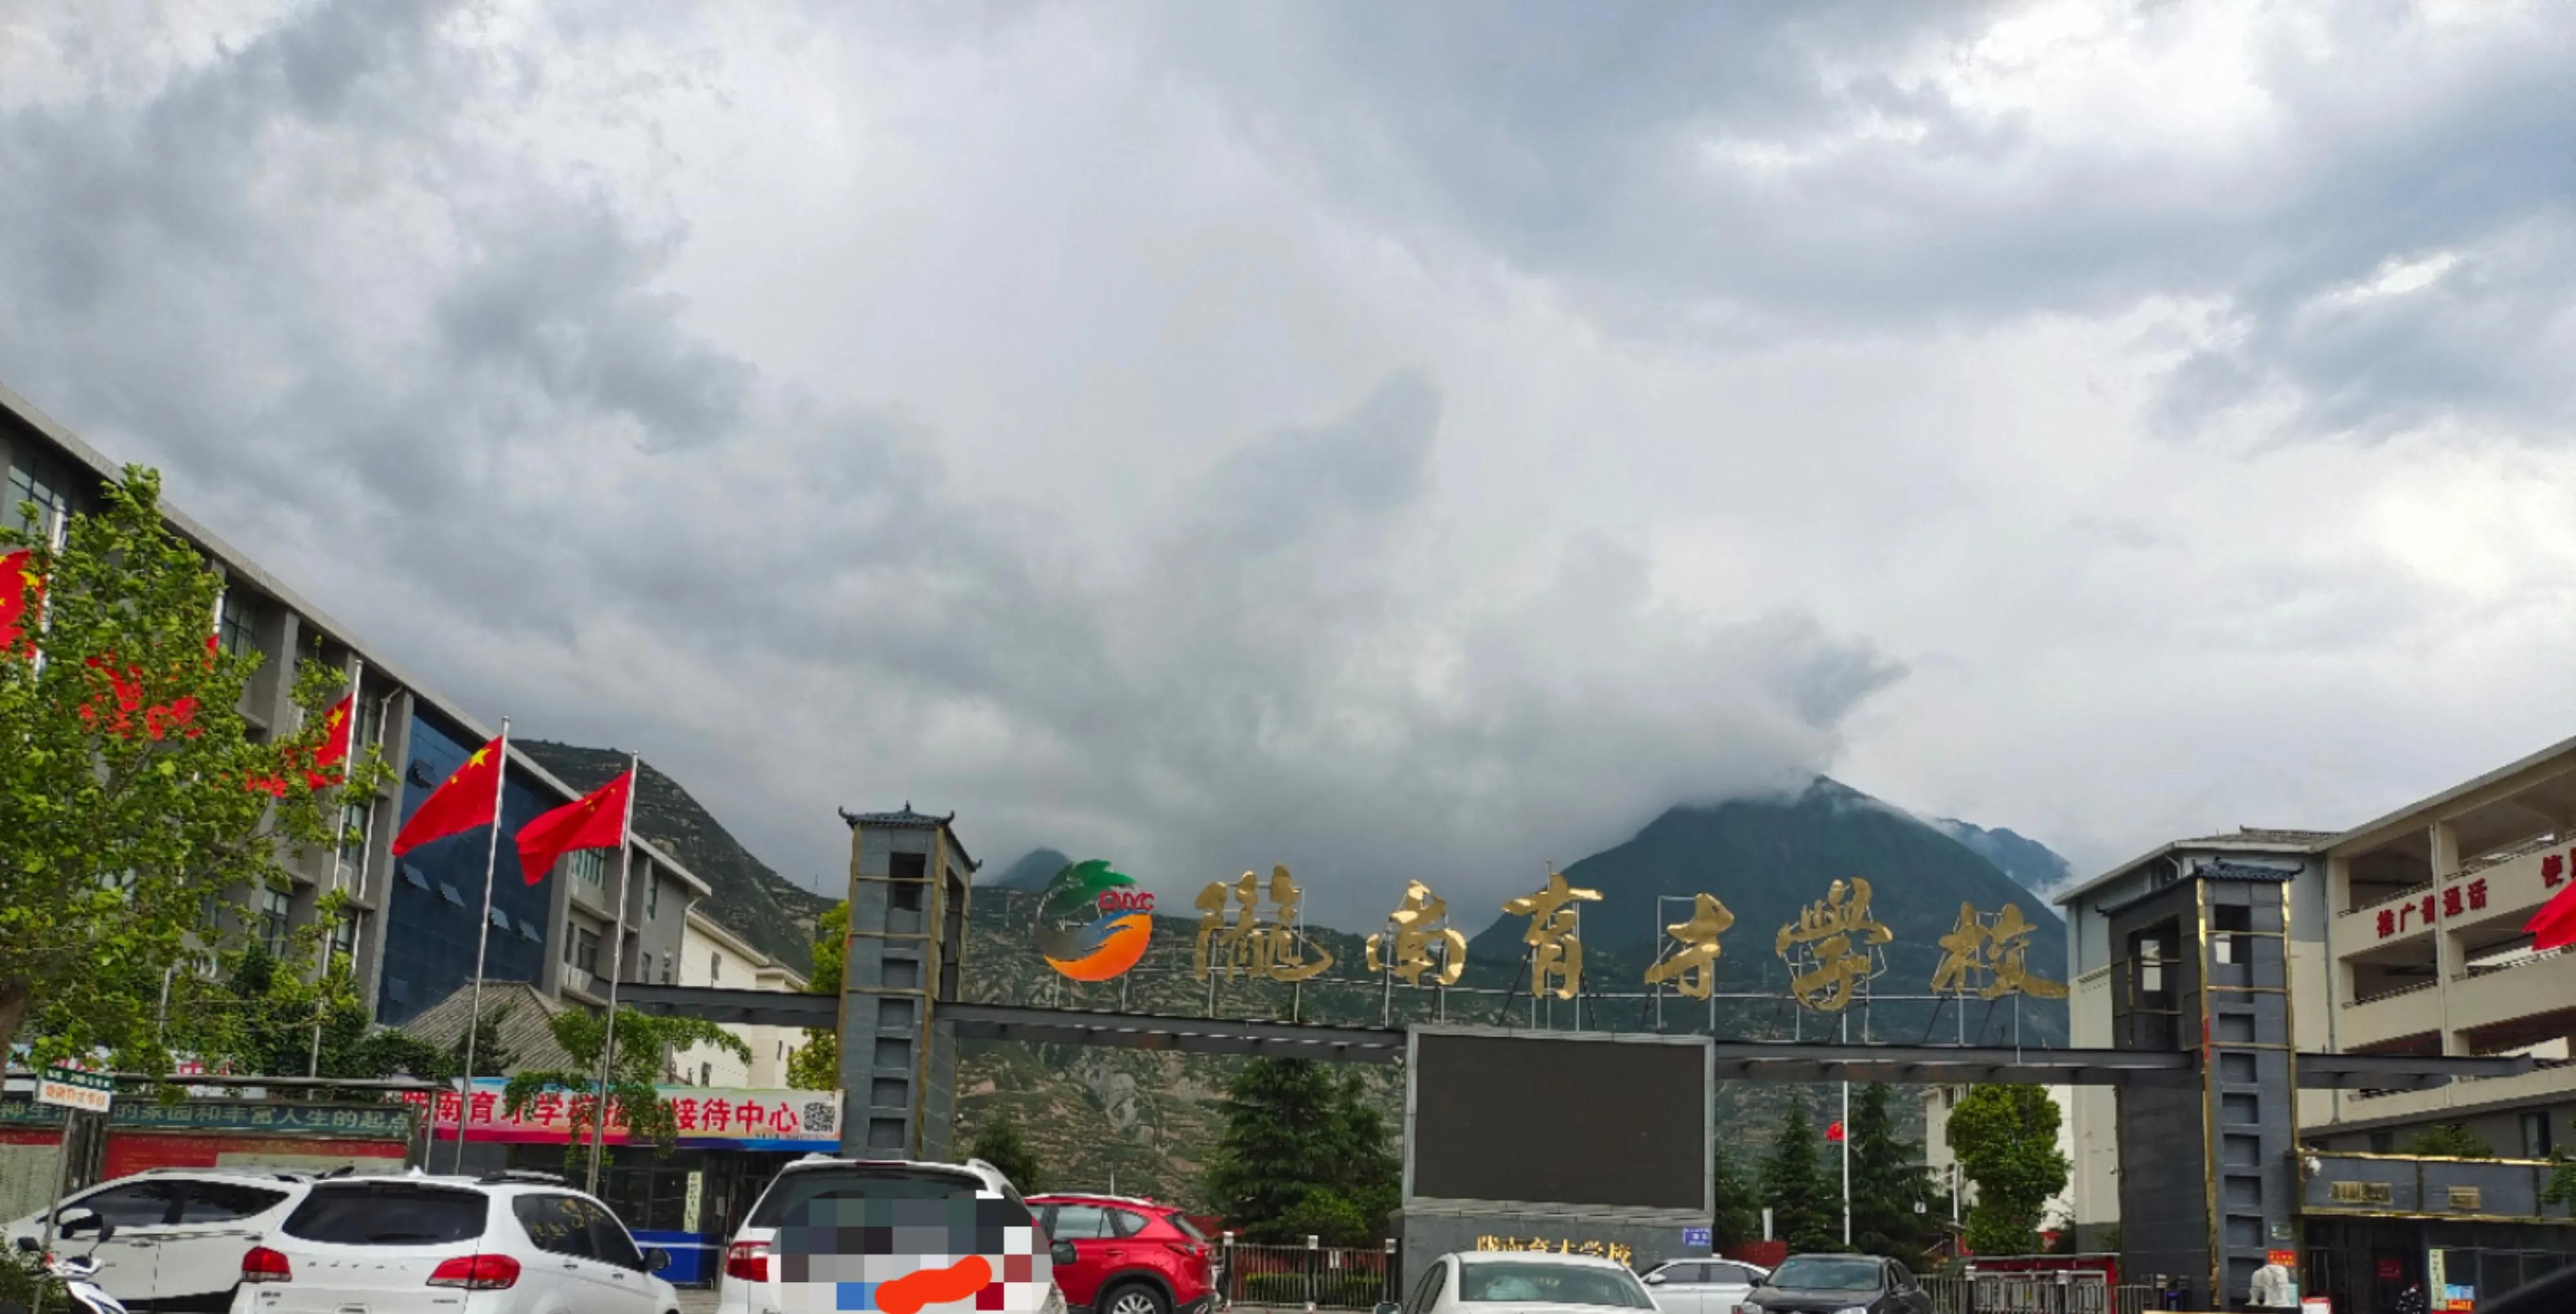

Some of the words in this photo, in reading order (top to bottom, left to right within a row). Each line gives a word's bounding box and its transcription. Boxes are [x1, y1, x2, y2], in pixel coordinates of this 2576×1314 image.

[0, 1100, 410, 1137] 神生的家园和丰富人生的起点
